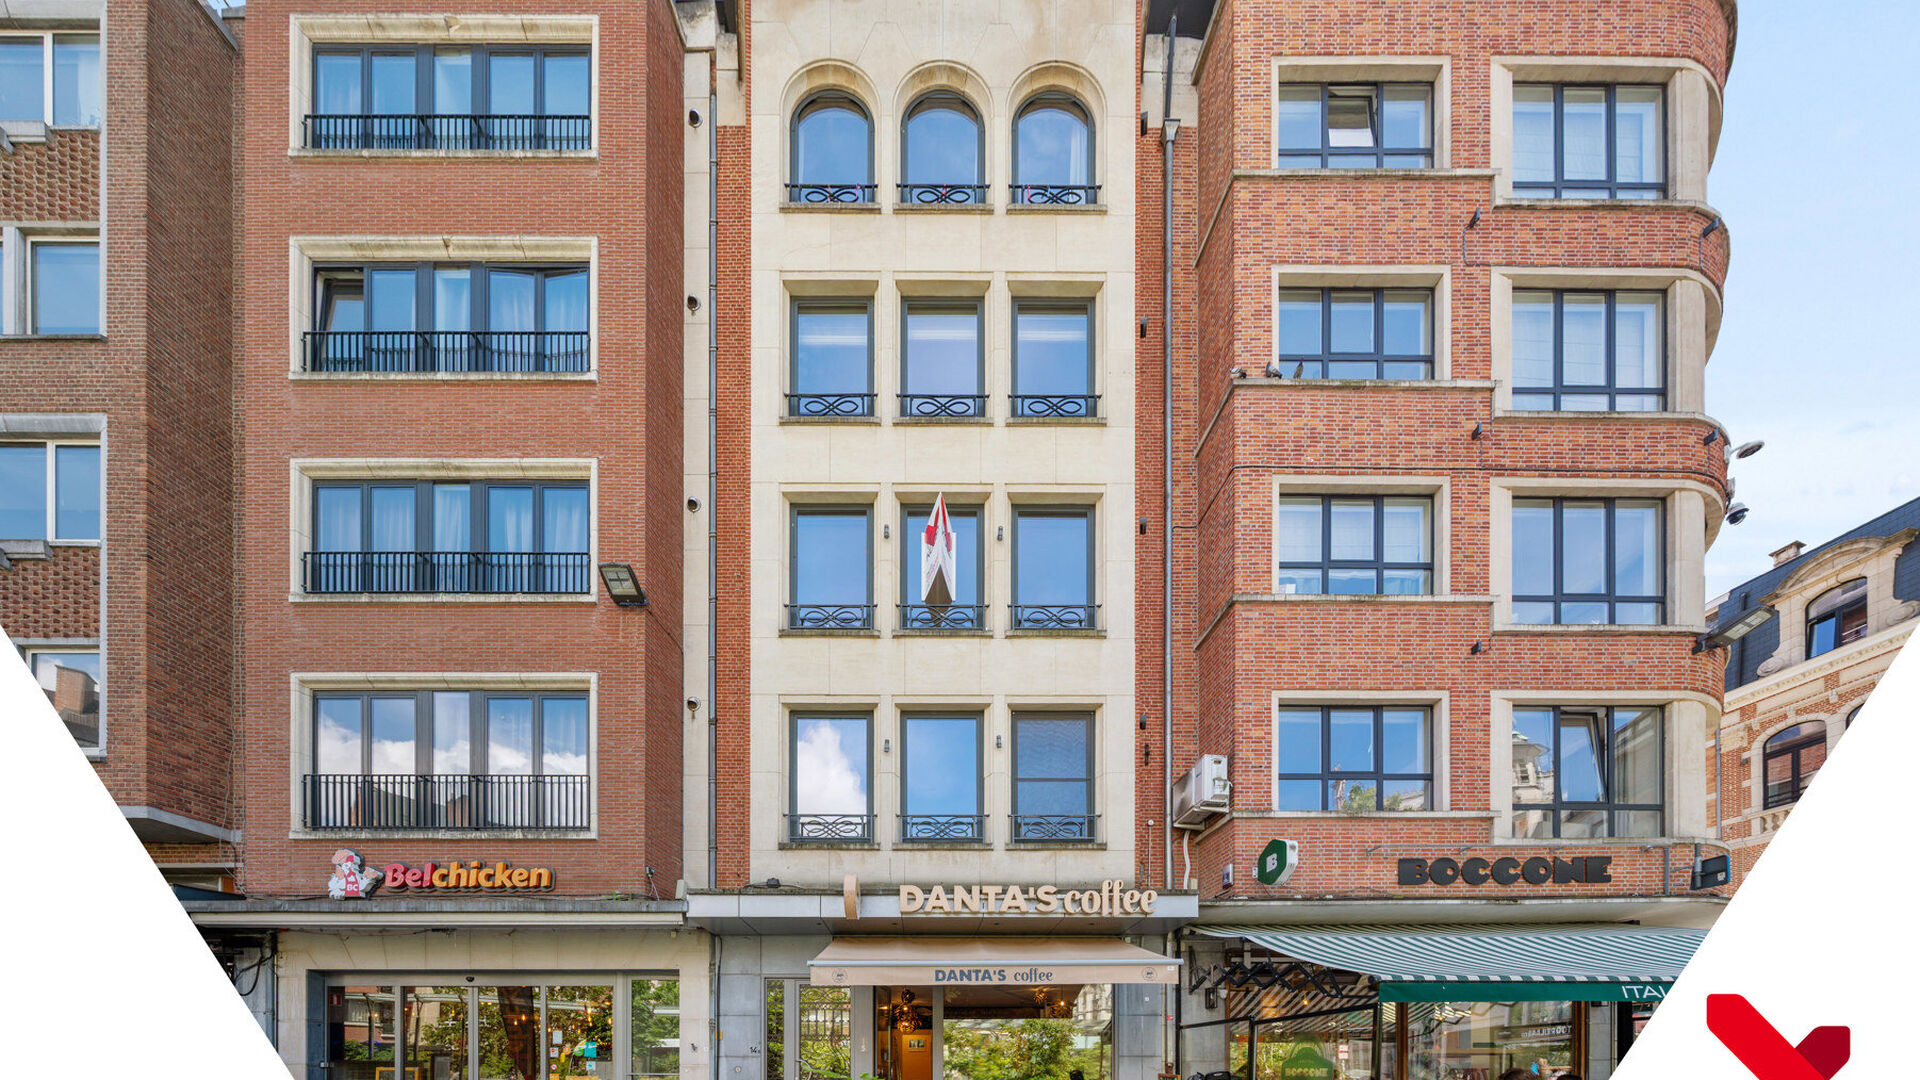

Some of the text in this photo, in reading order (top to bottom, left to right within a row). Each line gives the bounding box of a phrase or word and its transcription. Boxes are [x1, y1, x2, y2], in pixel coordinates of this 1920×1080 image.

[384, 860, 552, 889] Belchicken
[1266, 853, 1277, 872] B
[1398, 856, 1612, 885] BOCCONE
[346, 884, 358, 892] BC
[899, 879, 1158, 917] DANTA'S coffee
[934, 967, 1053, 983] DANTA'S coffee
